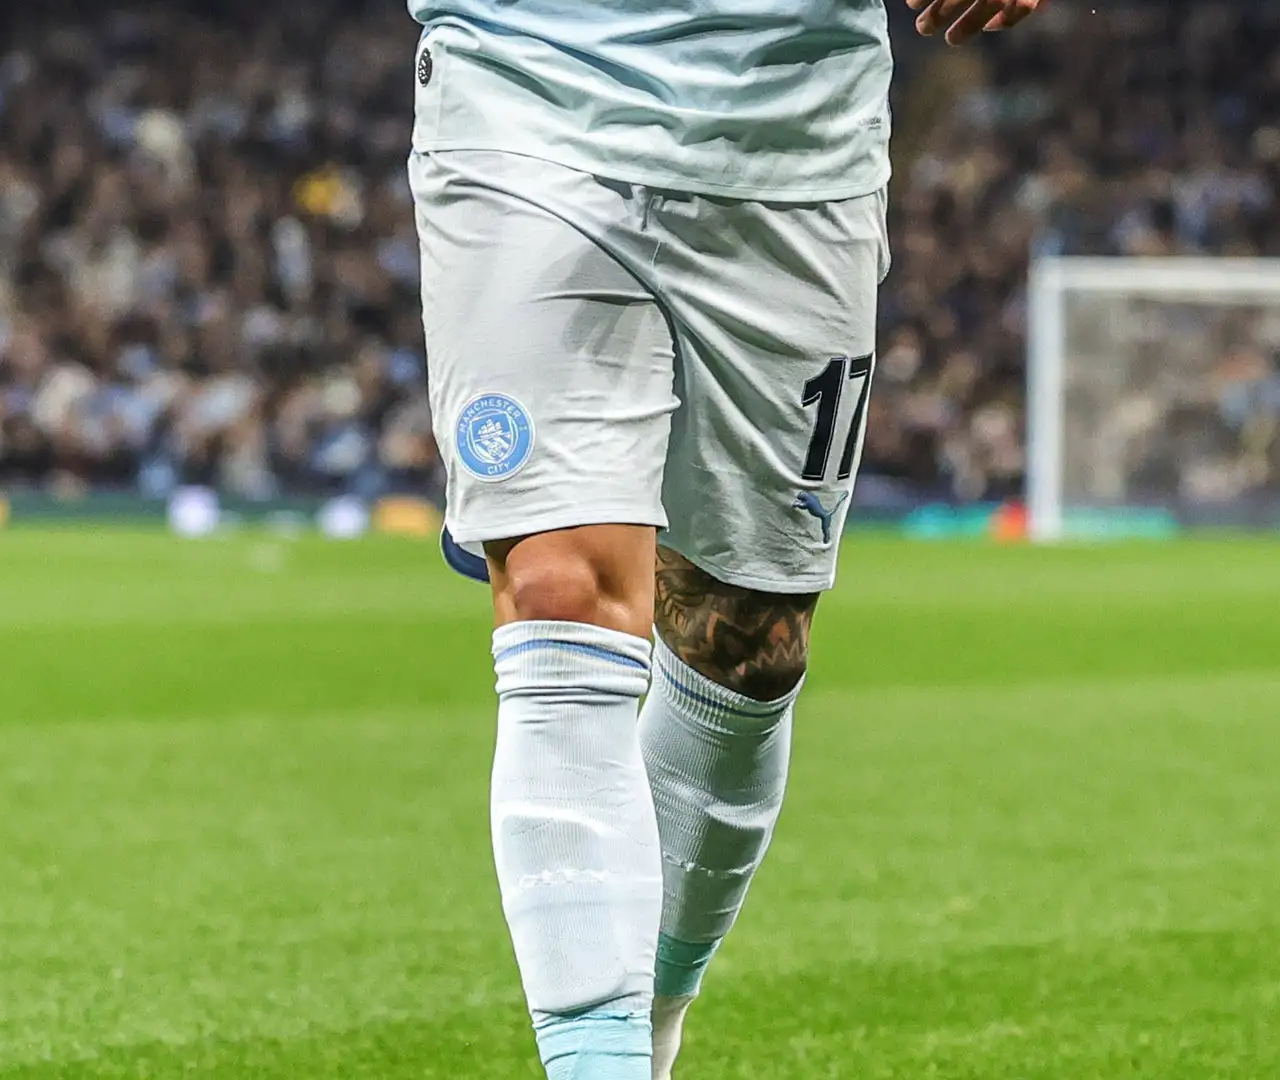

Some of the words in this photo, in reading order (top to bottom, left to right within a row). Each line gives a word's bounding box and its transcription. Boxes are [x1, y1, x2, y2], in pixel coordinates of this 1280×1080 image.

[460, 399, 521, 433] MANCHESTER
[801, 352, 874, 481] 17
[487, 461, 510, 475] CITY
